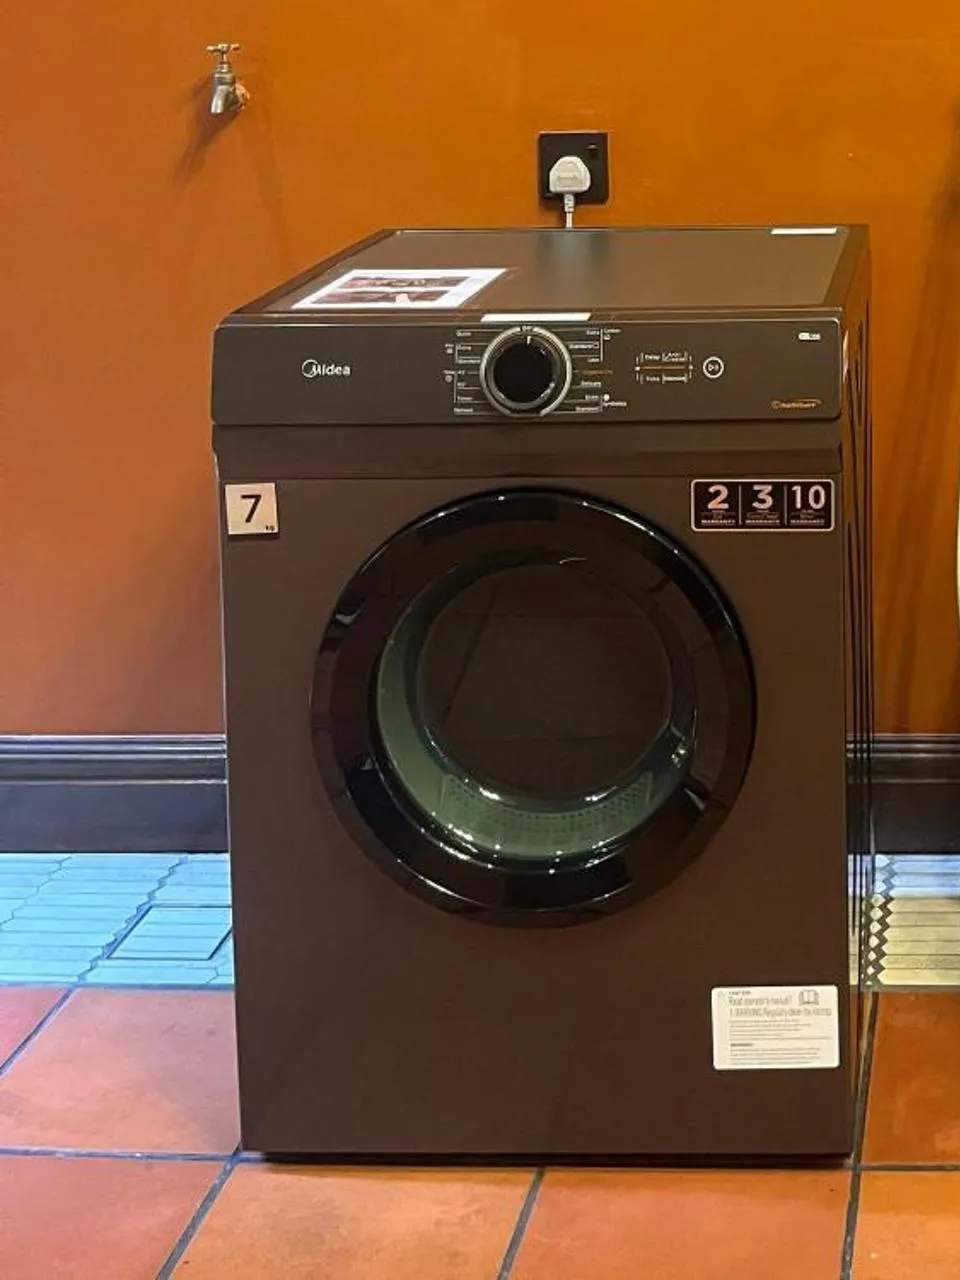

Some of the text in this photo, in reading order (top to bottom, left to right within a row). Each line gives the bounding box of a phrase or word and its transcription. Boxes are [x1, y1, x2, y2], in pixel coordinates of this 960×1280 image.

[301, 358, 351, 378] Midea
[241, 494, 262, 523] 7
[707, 484, 729, 510] 2
[751, 484, 774, 510] 3
[791, 484, 826, 510] 10
